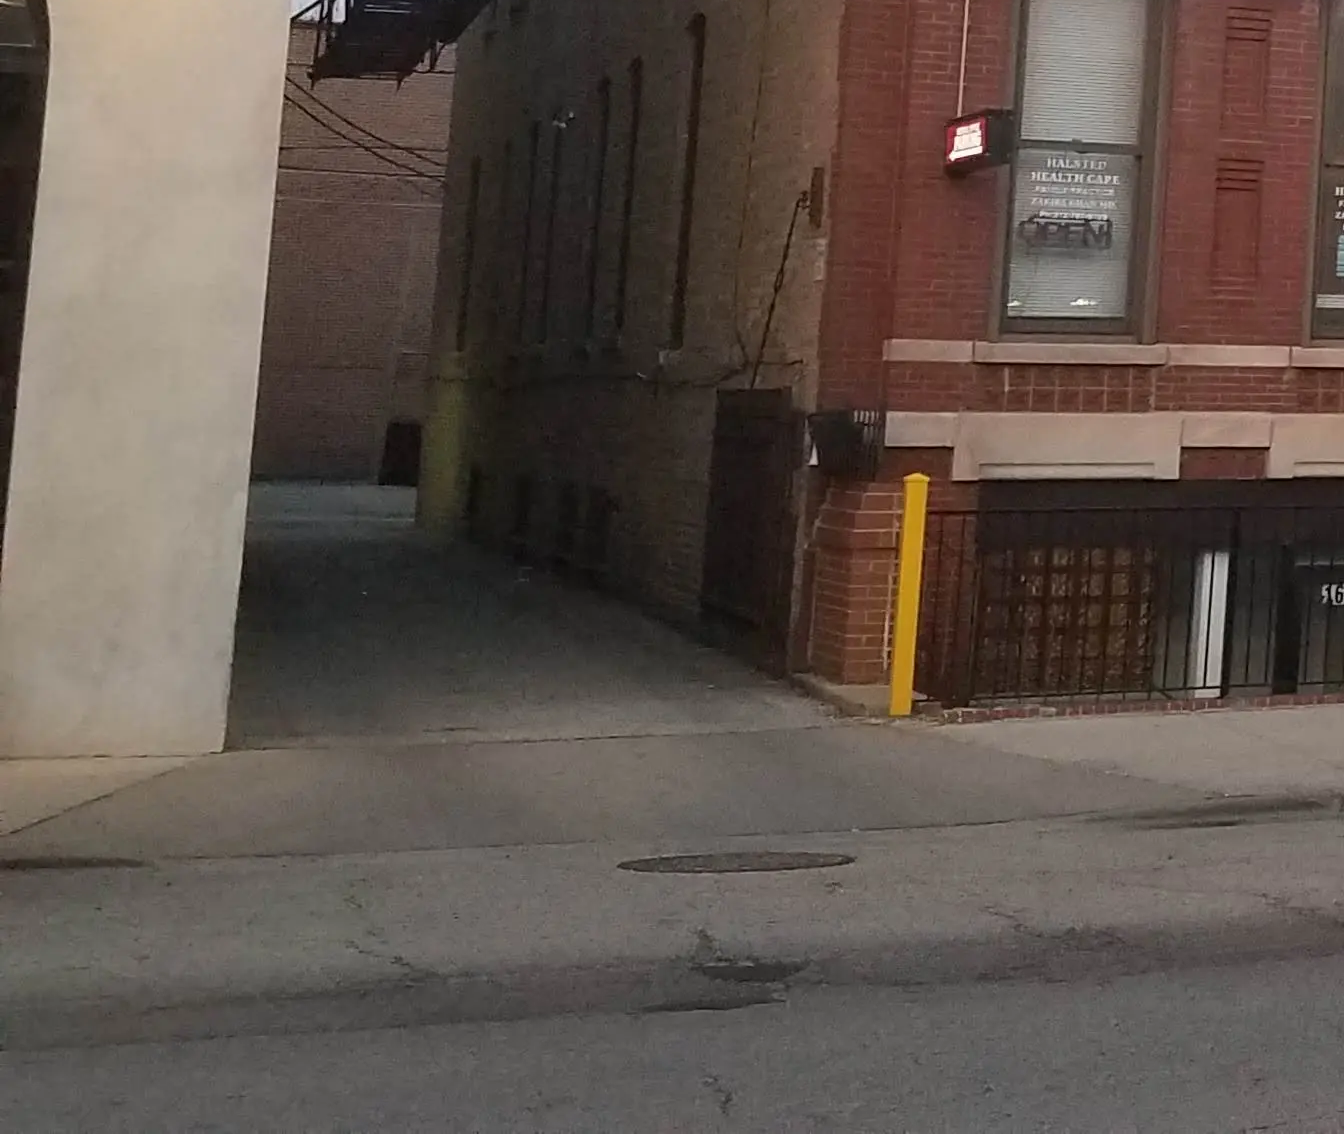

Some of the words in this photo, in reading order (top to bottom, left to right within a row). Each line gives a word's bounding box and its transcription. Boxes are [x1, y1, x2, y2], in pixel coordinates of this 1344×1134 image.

[1046, 157, 1107, 171] HALSTED
[1030, 171, 1084, 184] HEALTH
[1086, 173, 1121, 185] CARE
[1017, 215, 1113, 250] OPEN
